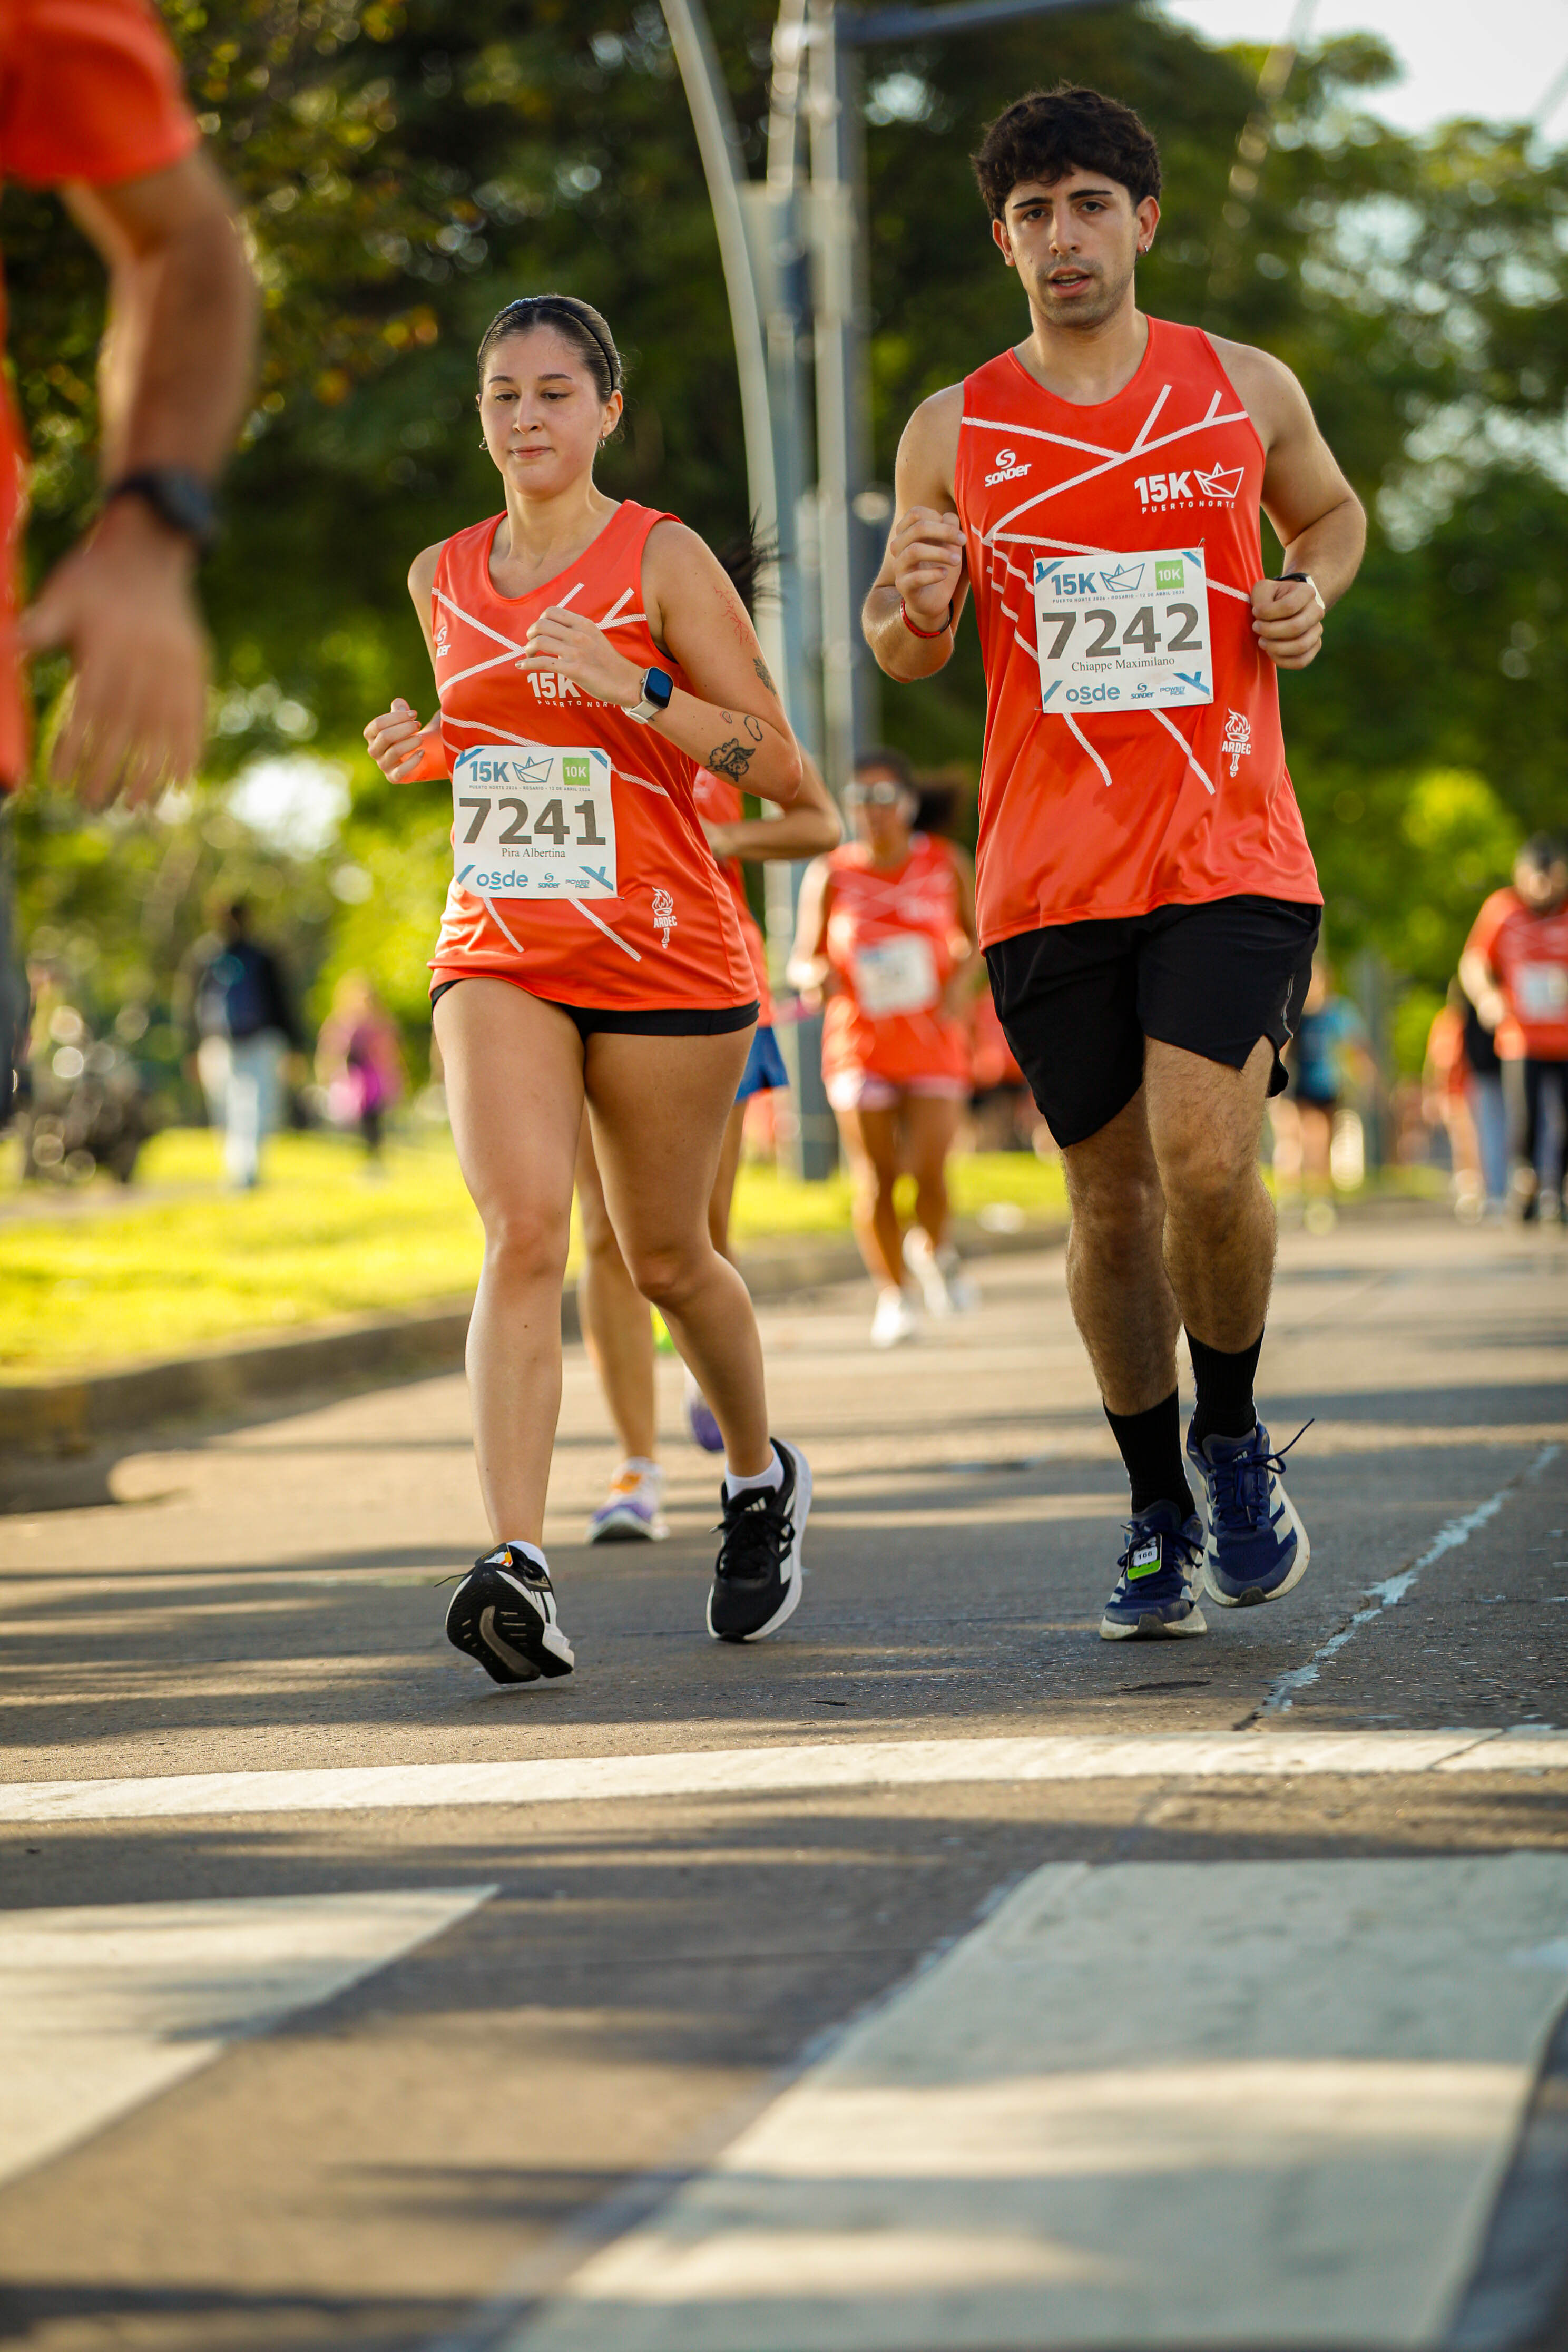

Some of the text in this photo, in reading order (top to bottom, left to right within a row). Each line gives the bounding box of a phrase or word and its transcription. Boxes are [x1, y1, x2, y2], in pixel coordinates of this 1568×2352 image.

[1134, 471, 1194, 505] 15K
[1142, 500, 1235, 514] PUERTO NORTE
[1051, 572, 1097, 596] 15K
[1158, 569, 1181, 581] 10K
[1042, 602, 1203, 660] 7242
[1071, 656, 1175, 673] Chiappe Maximilano
[527, 672, 581, 699] 15K
[1065, 682, 1121, 702] osde
[1222, 740, 1252, 756] ARDEC
[469, 760, 511, 783] 15K
[565, 766, 587, 778] 10K
[459, 797, 606, 846] 7241
[501, 848, 566, 858] Pira Albertina
[476, 869, 528, 887] osde
[653, 915, 678, 928] ARDEC
